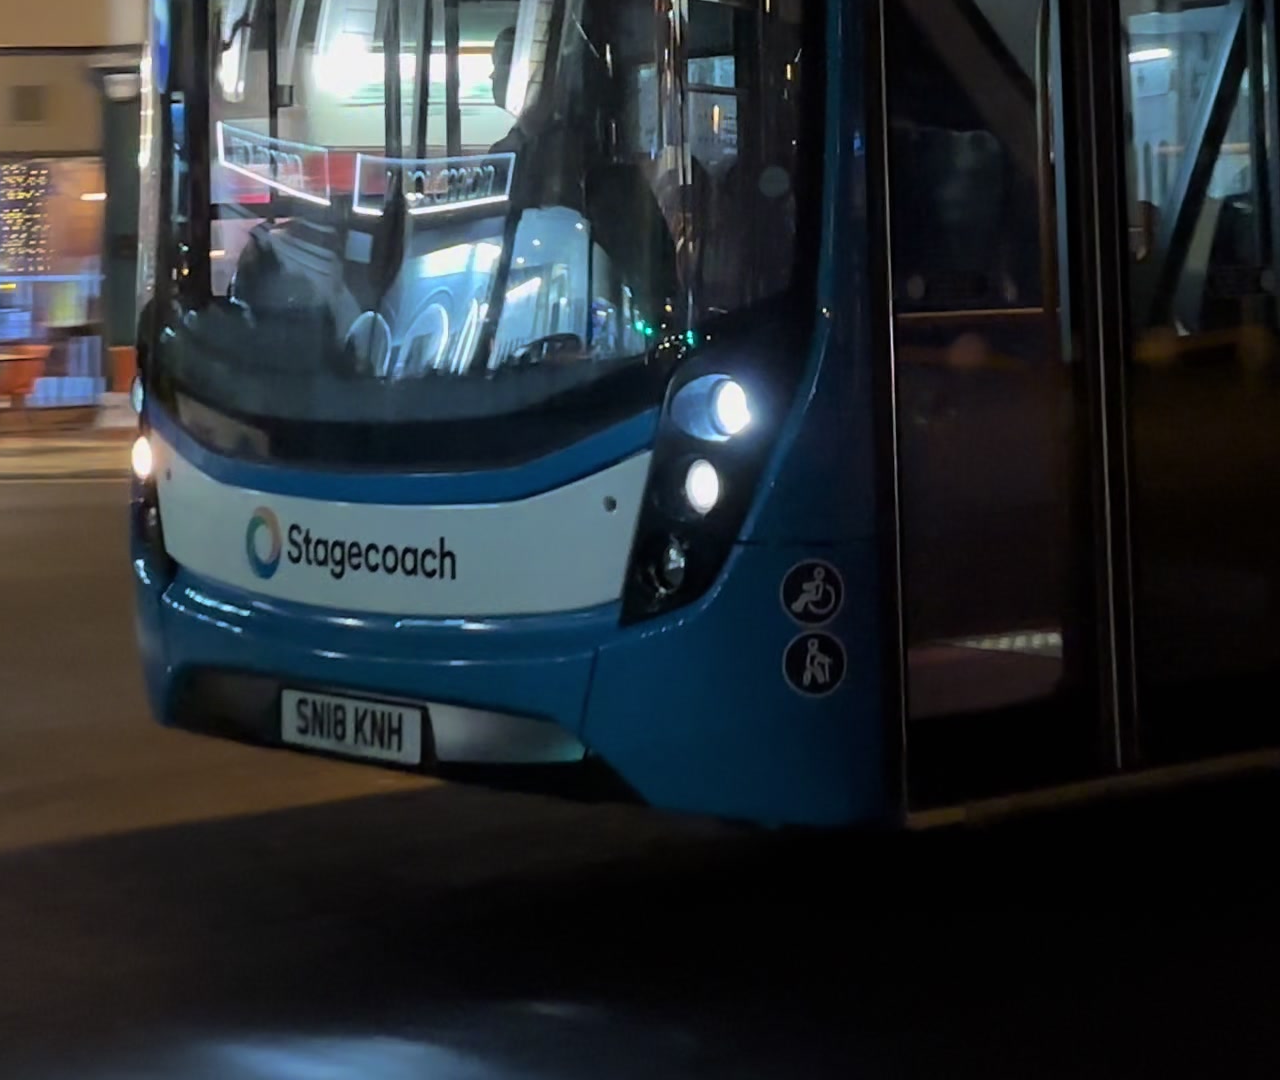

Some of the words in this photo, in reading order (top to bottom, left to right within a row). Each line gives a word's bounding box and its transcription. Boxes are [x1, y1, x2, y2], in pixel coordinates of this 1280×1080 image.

[287, 523, 458, 581] Stagecoach
[295, 699, 347, 739] SN18
[353, 706, 404, 753] KNH
